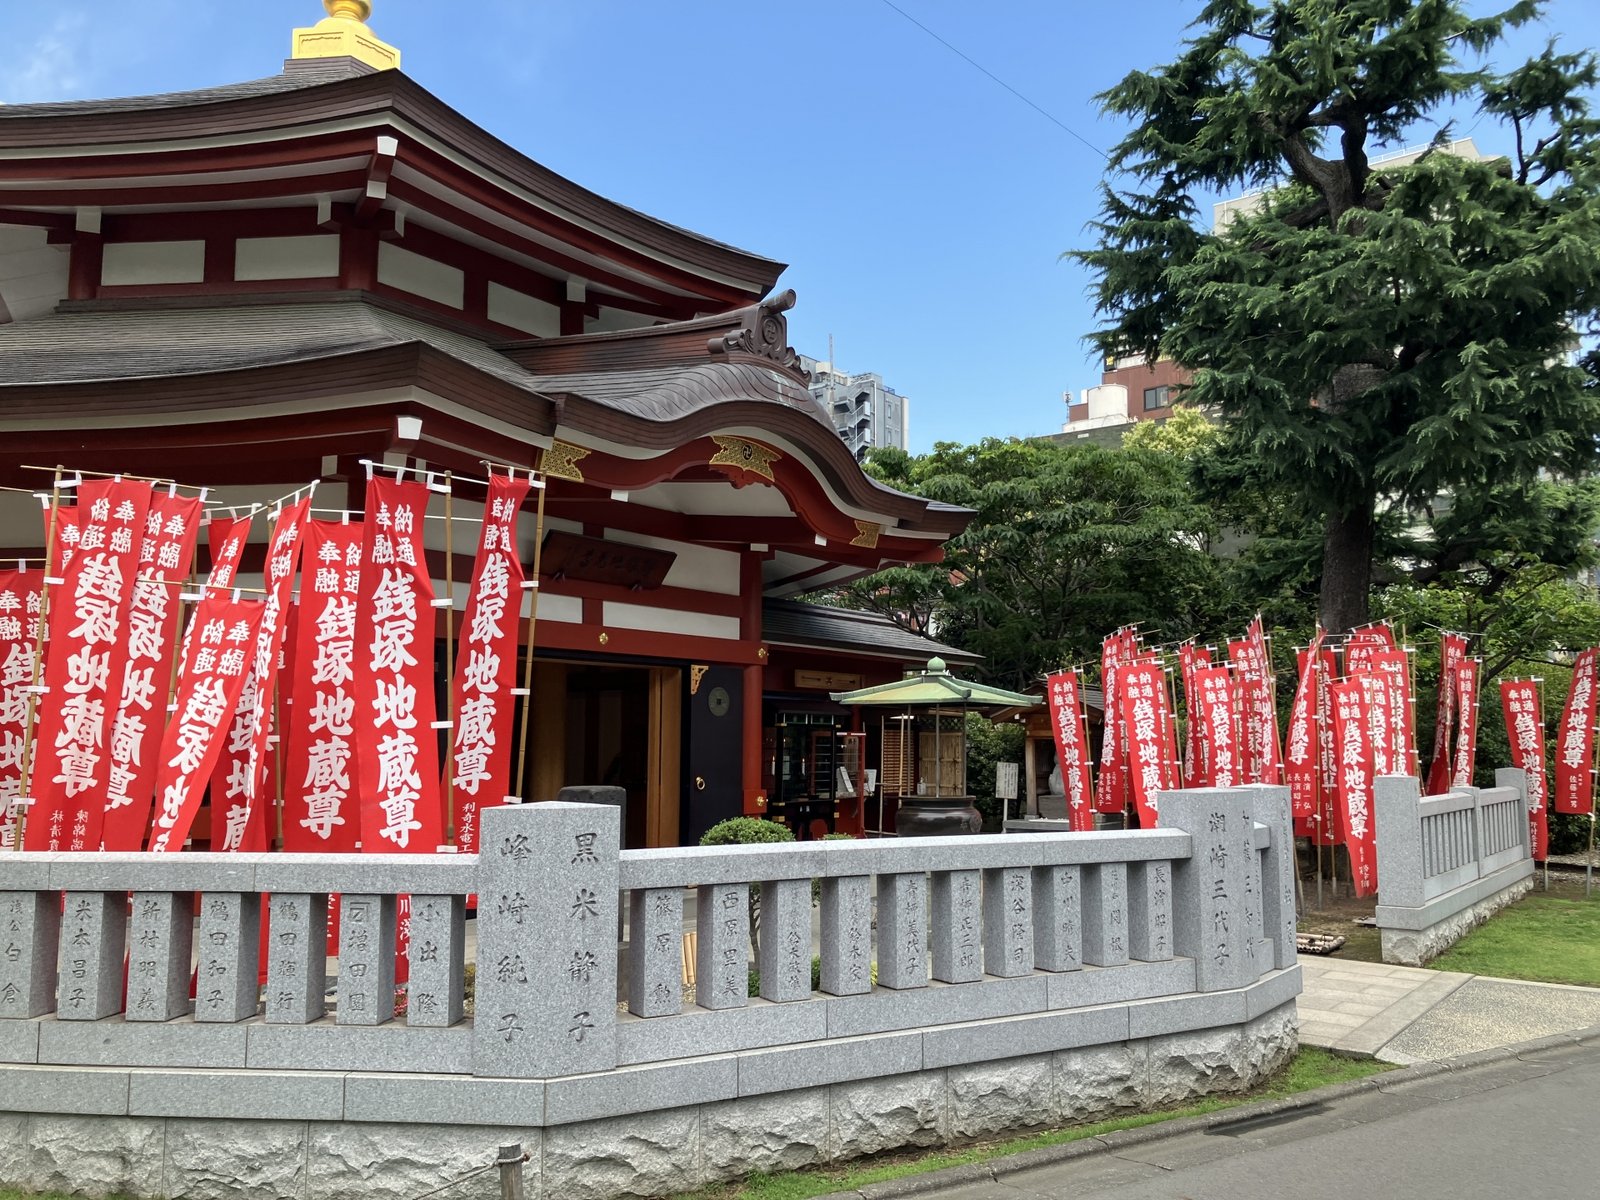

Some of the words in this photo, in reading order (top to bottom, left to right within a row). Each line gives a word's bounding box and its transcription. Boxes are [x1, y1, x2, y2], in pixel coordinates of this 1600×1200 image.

[372, 533, 417, 566] 融通
[376, 502, 413, 534] 奉納
[300, 596, 356, 839] 銭塚地蔵尊
[369, 567, 422, 848] 銭塚地蔵尊
[453, 552, 508, 796] 銭塚地蔵尊
[1562, 678, 1592, 768] 銭塚地蔵尊
[1058, 706, 1083, 810] 銭塚地蔵尊
[1132, 698, 1162, 812] 銭塚地蔵尊
[1343, 720, 1368, 840] 銭塚地蔵尊
[1514, 712, 1543, 813] 銭塚地蔵尊
